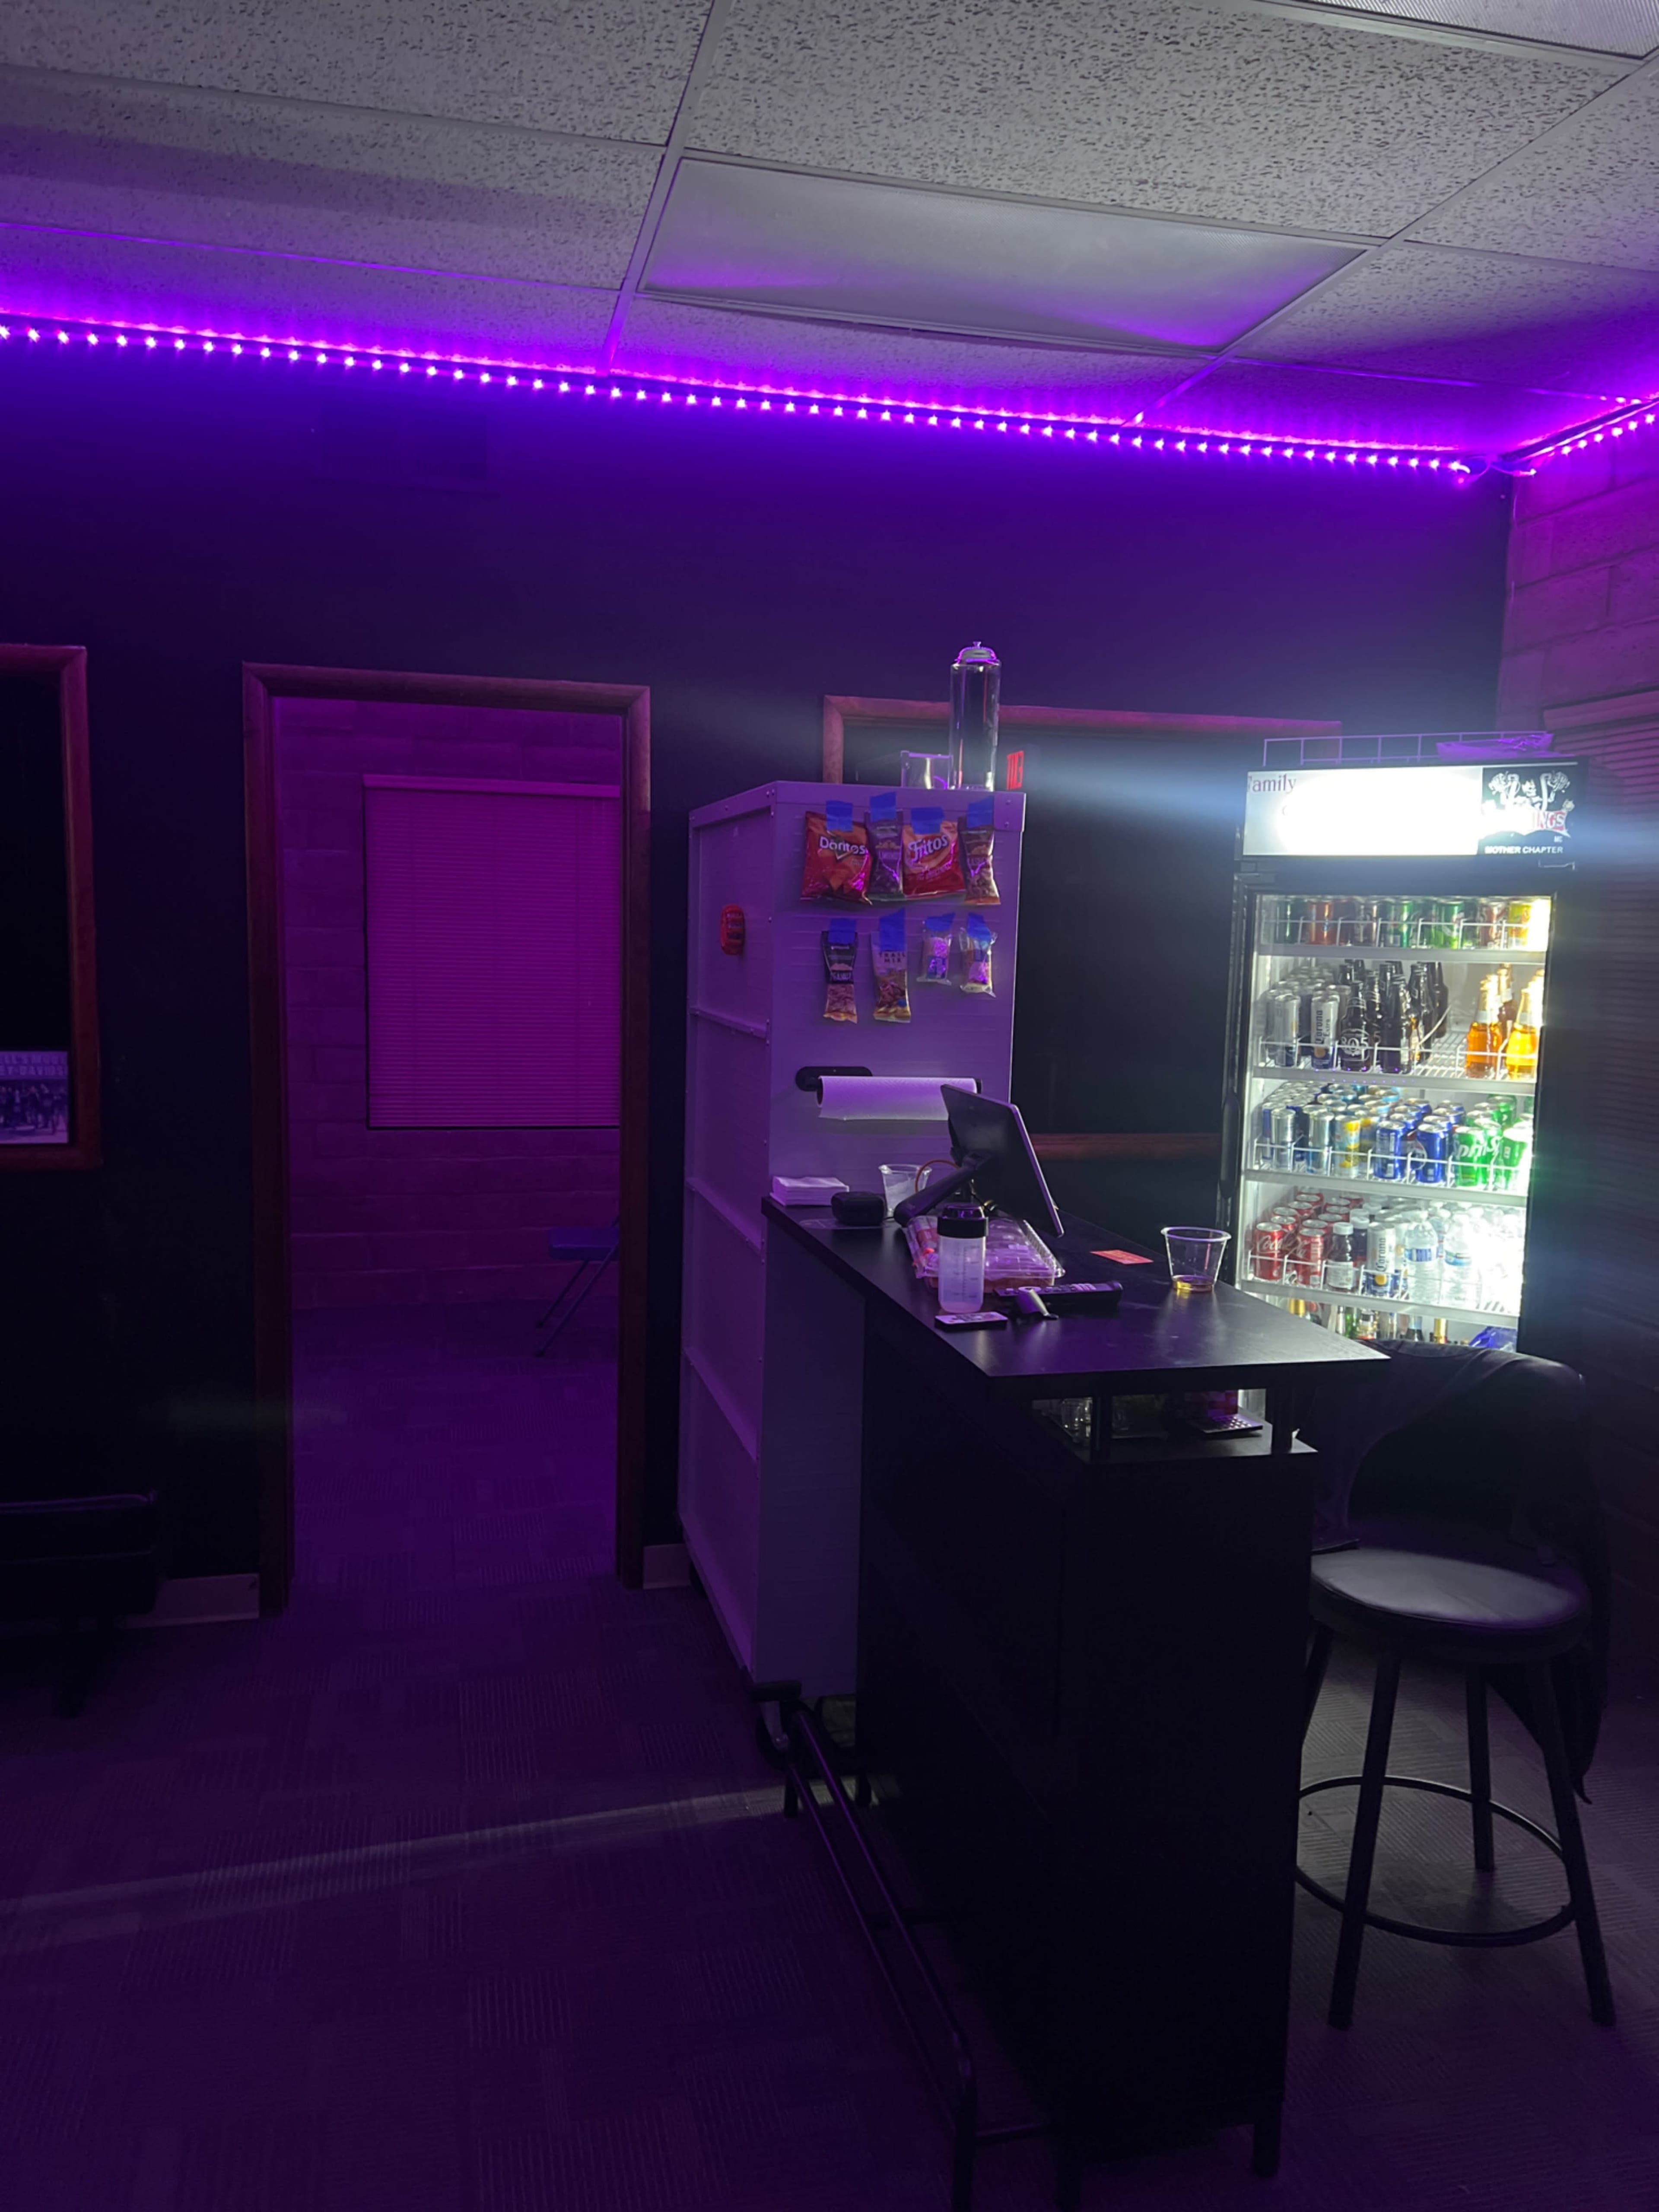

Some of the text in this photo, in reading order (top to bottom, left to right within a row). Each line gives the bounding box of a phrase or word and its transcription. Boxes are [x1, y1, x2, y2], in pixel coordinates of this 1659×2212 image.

[820, 836, 866, 855] Doritos
[908, 835, 948, 863] Fritos
[1484, 845, 1521, 854] MOTHER
[1376, 1238, 1386, 1272] Corona
